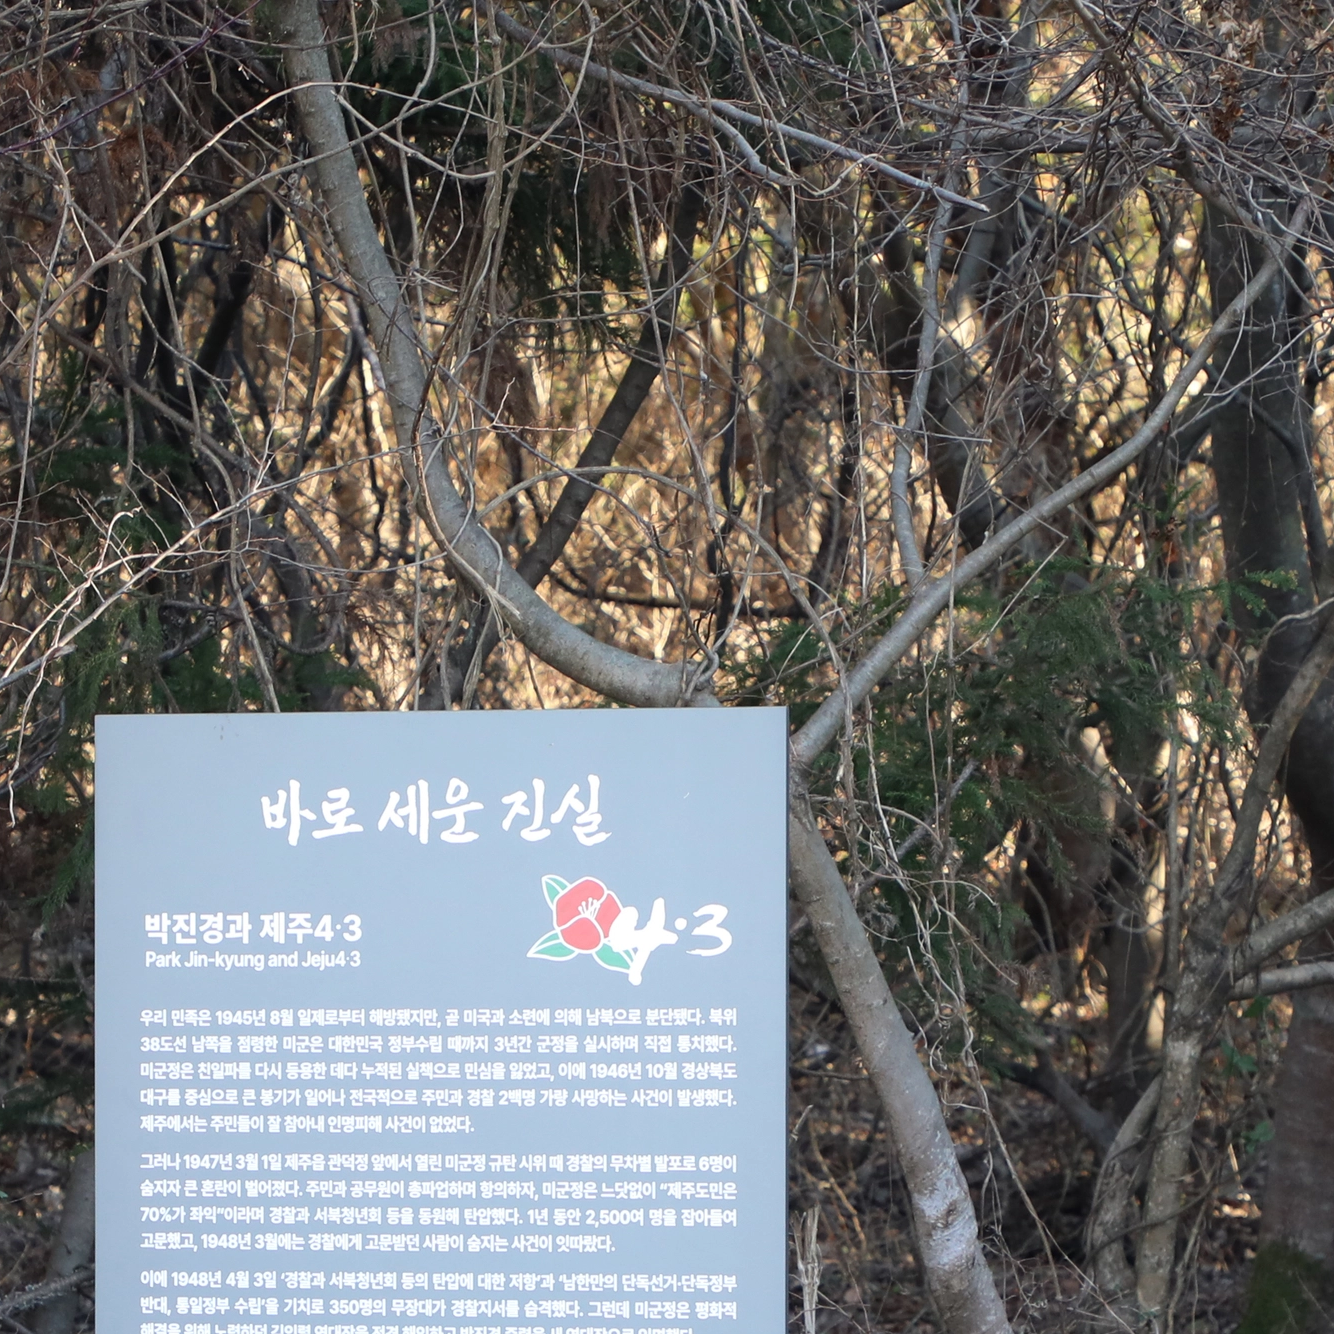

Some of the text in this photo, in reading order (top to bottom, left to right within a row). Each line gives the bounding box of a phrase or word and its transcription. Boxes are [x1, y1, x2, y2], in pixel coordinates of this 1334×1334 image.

[260, 774, 612, 847] 바로 세운 진실
[145, 911, 362, 945] 박진경과 제주4·3
[145, 950, 361, 972] Park Jin-kyung and Jeju4·3
[139, 1007, 736, 1028] 우리 민족은 1945년 8월 일제로부터 해방됐지만, 곧 미국과 소련에 의해 남북으로 분단됐다. 북위
[140, 1034, 737, 1053] 38도선 남쪽을 점령한 미군은 대한민국 정부수립 때까지 3년간 군정을 실시하며 직접 통치했다.
[140, 1088, 737, 1107] 대구를 중심으로 큰 봉기가 일어나 전국적으로 주민과 경찰 2백명 가량 사망하는 사건이 발생했다.
[140, 1114, 474, 1133] 제주에서는 주민들이 잘 참아내 인명피해 사건이 없었다.
[140, 1231, 615, 1253] 고문했고, 1948년 3월에는 경찰에게 고문받던 사람이 숨지는 사건이 잇따랐다.
[140, 1296, 171, 1316] 반대,
[175, 1296, 230, 1314] 통일정부
[283, 1297, 324, 1315] 기치로
[329, 1298, 386, 1316] 350명의
[391, 1298, 446, 1317] 무장대가
[451, 1299, 519, 1317] 경찰지서를
[523, 1299, 583, 1318] 습격했다.
[587, 1300, 629, 1318] 그런데
[635, 1300, 690, 1319] 미군정은
[695, 1301, 736, 1319] 평화적
